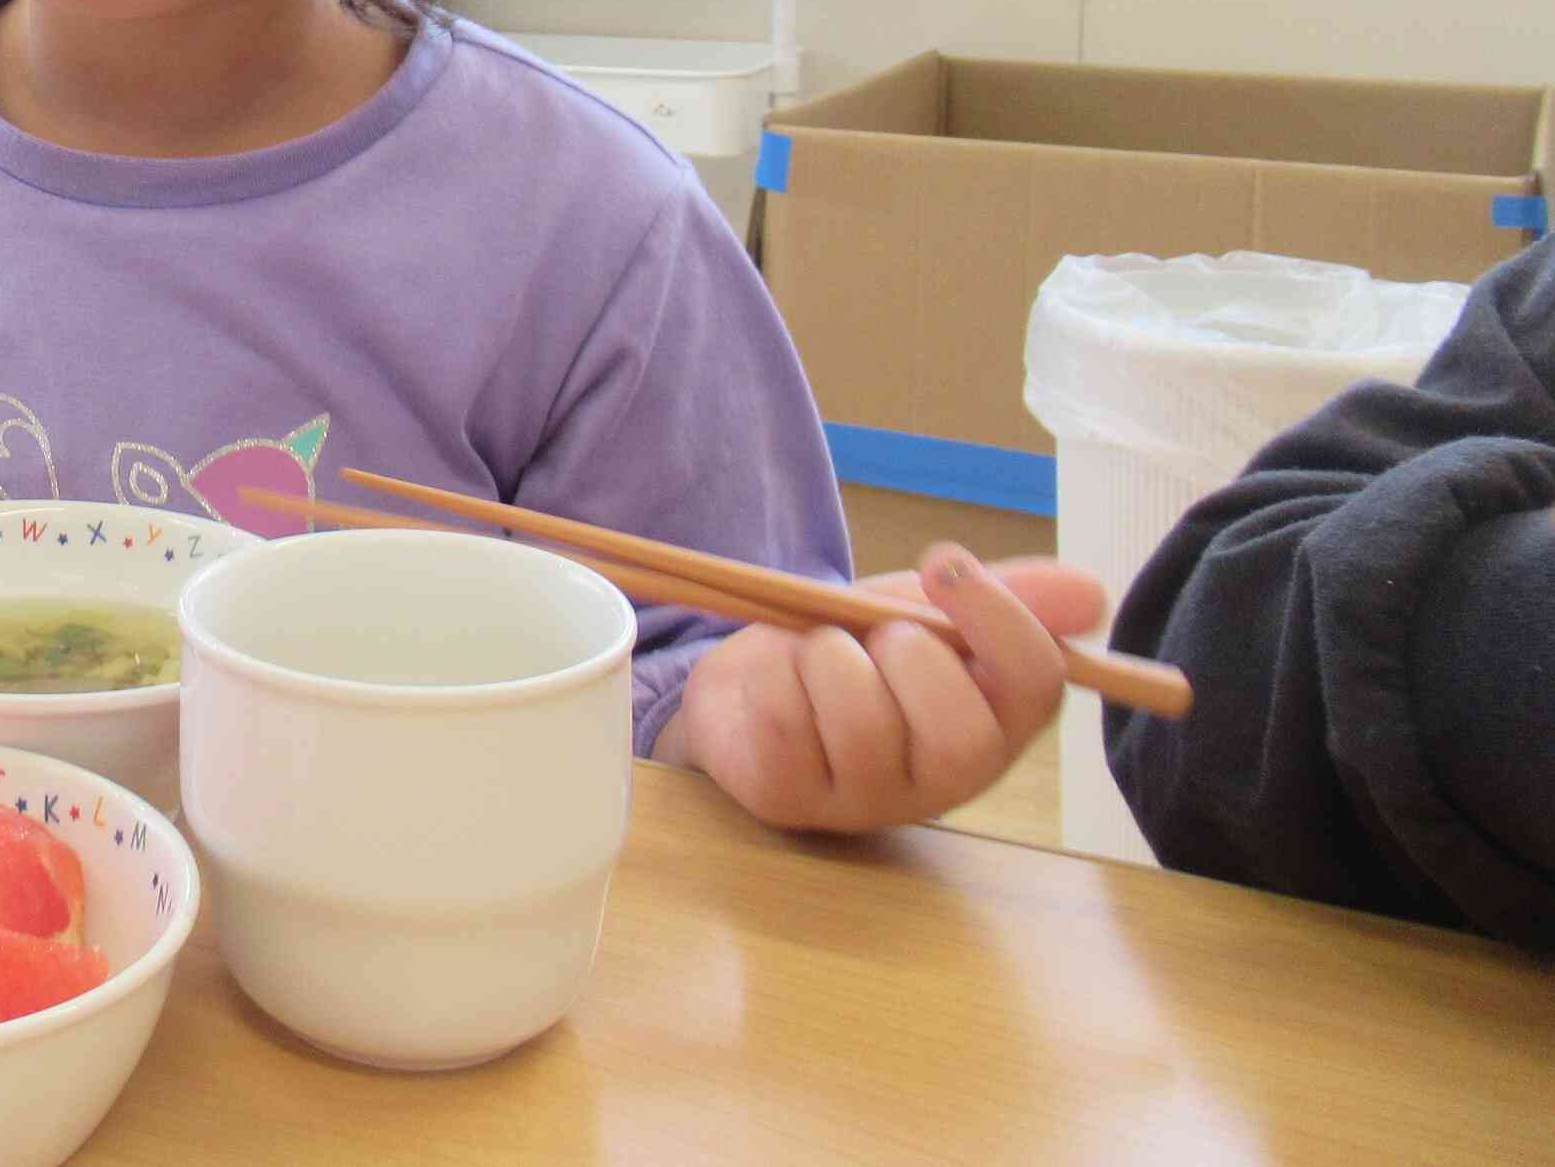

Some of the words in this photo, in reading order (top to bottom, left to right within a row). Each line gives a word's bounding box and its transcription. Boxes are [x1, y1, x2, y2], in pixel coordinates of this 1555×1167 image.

[21, 517, 48, 543] W
[86, 519, 108, 546] X
[187, 533, 205, 559] Z
[44, 794, 60, 824] K
[93, 796, 106, 827] L
[130, 820, 147, 851] M
